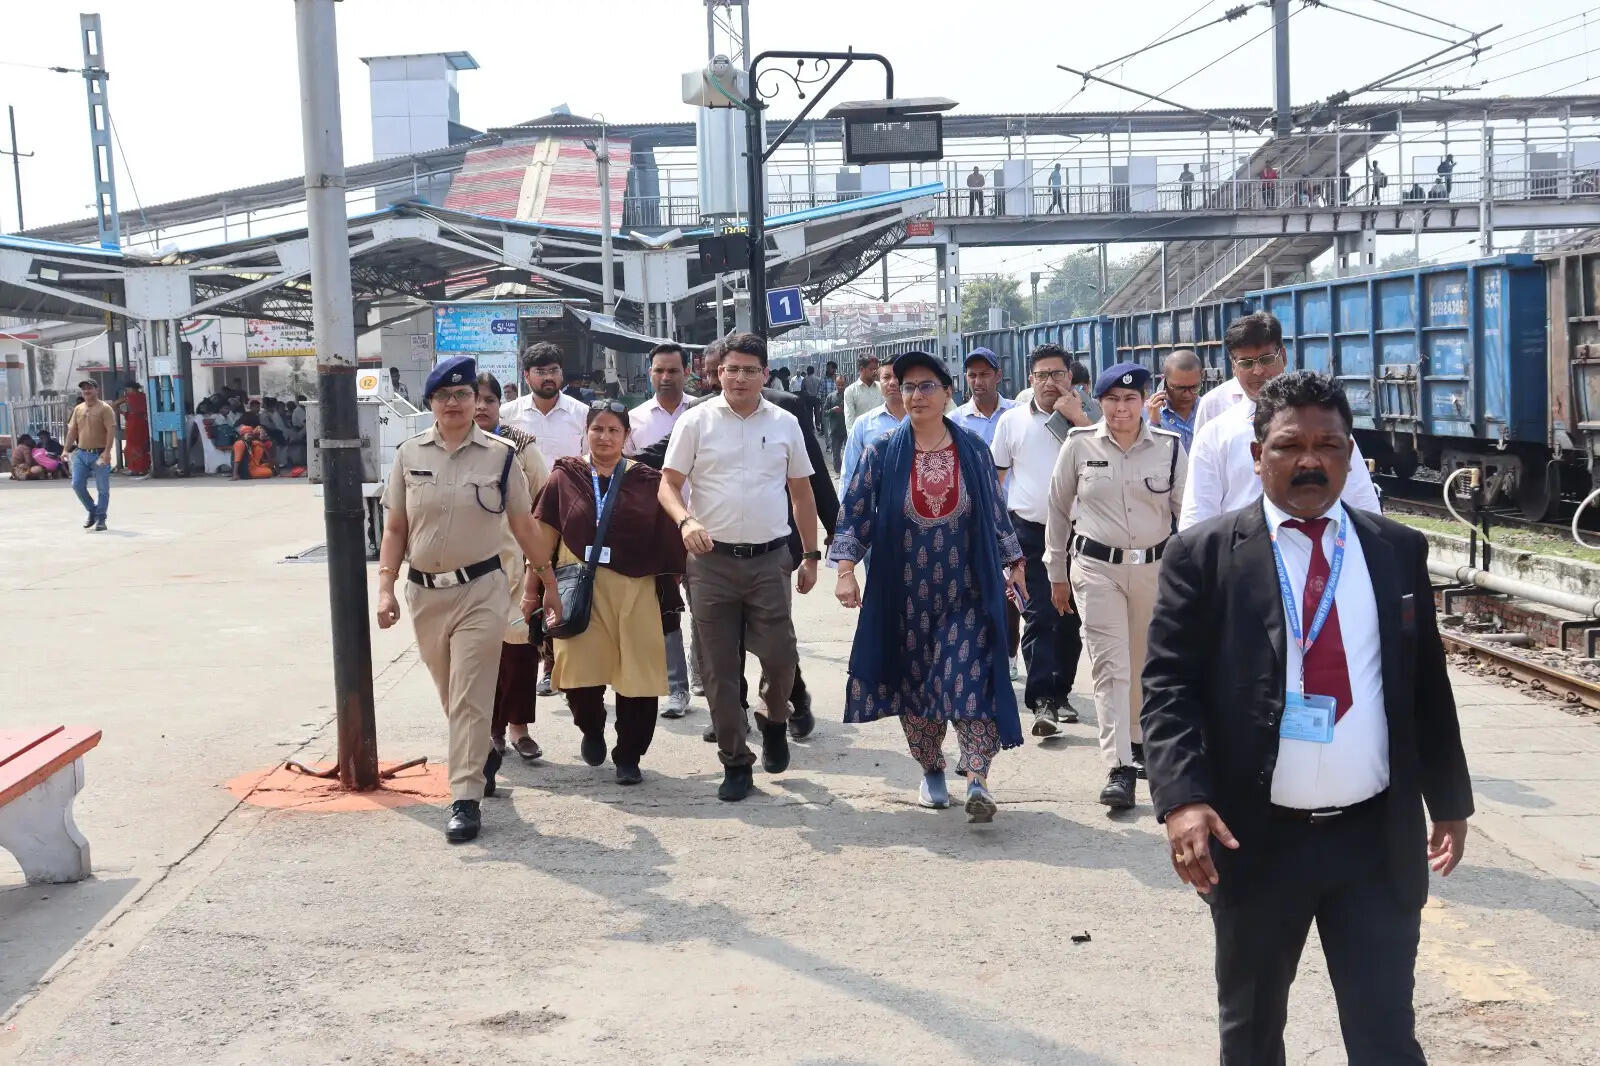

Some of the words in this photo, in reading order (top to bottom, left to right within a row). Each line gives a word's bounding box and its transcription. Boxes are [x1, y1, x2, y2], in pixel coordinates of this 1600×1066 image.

[780, 296, 791, 315] 1
[1282, 583, 1290, 594] OF
[1312, 601, 1329, 632] MINISTRY
[1325, 588, 1333, 598] OF
[1330, 554, 1342, 588] RAILWAYS
